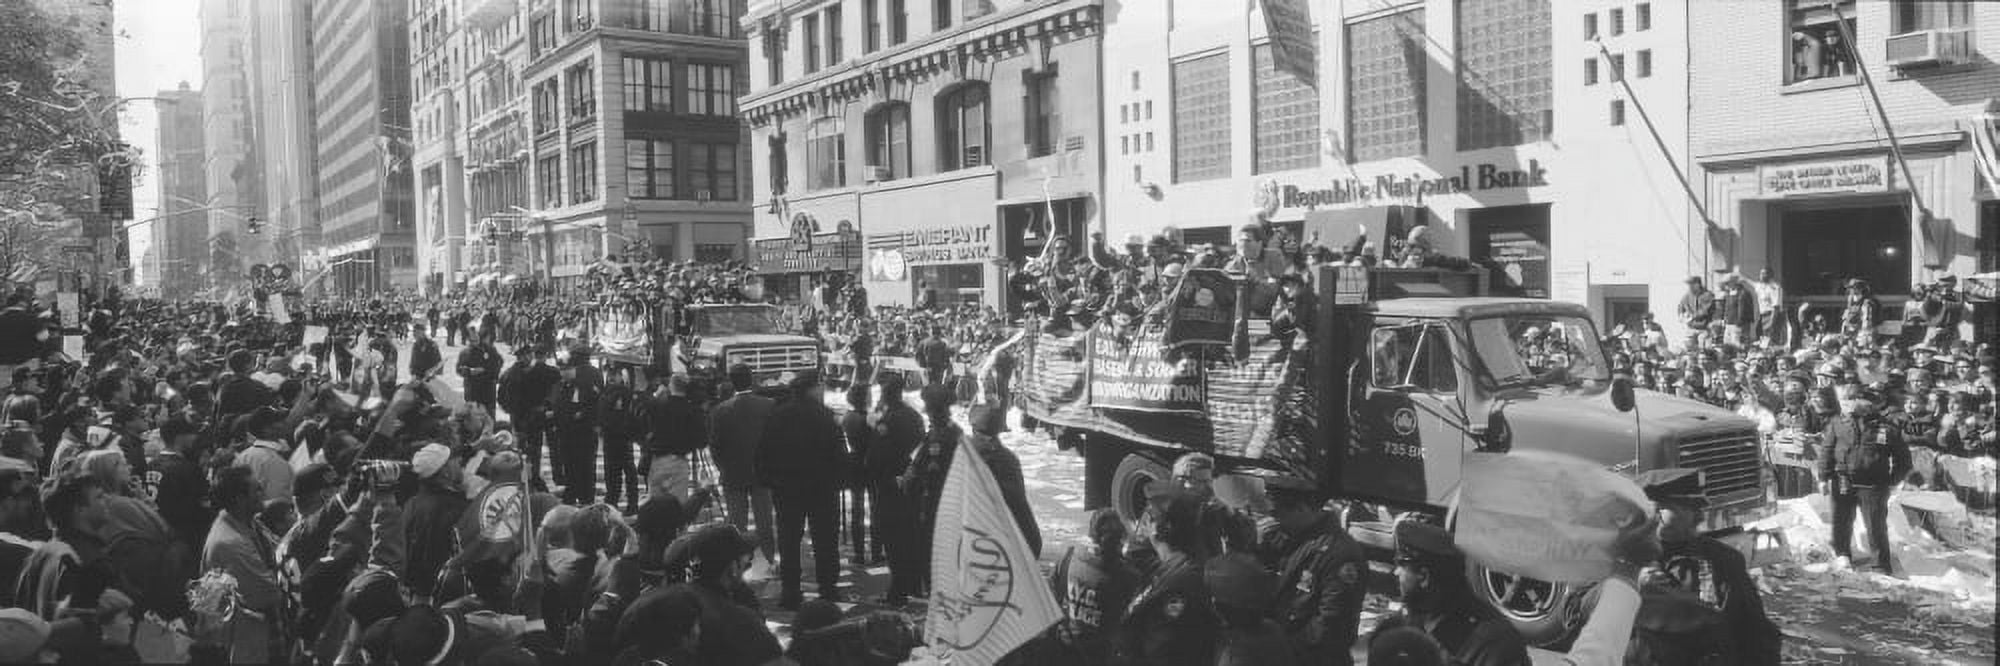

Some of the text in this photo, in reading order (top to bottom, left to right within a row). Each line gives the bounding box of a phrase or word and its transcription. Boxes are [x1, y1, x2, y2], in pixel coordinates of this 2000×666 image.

[1284, 159, 1548, 210] Republic National Bank
